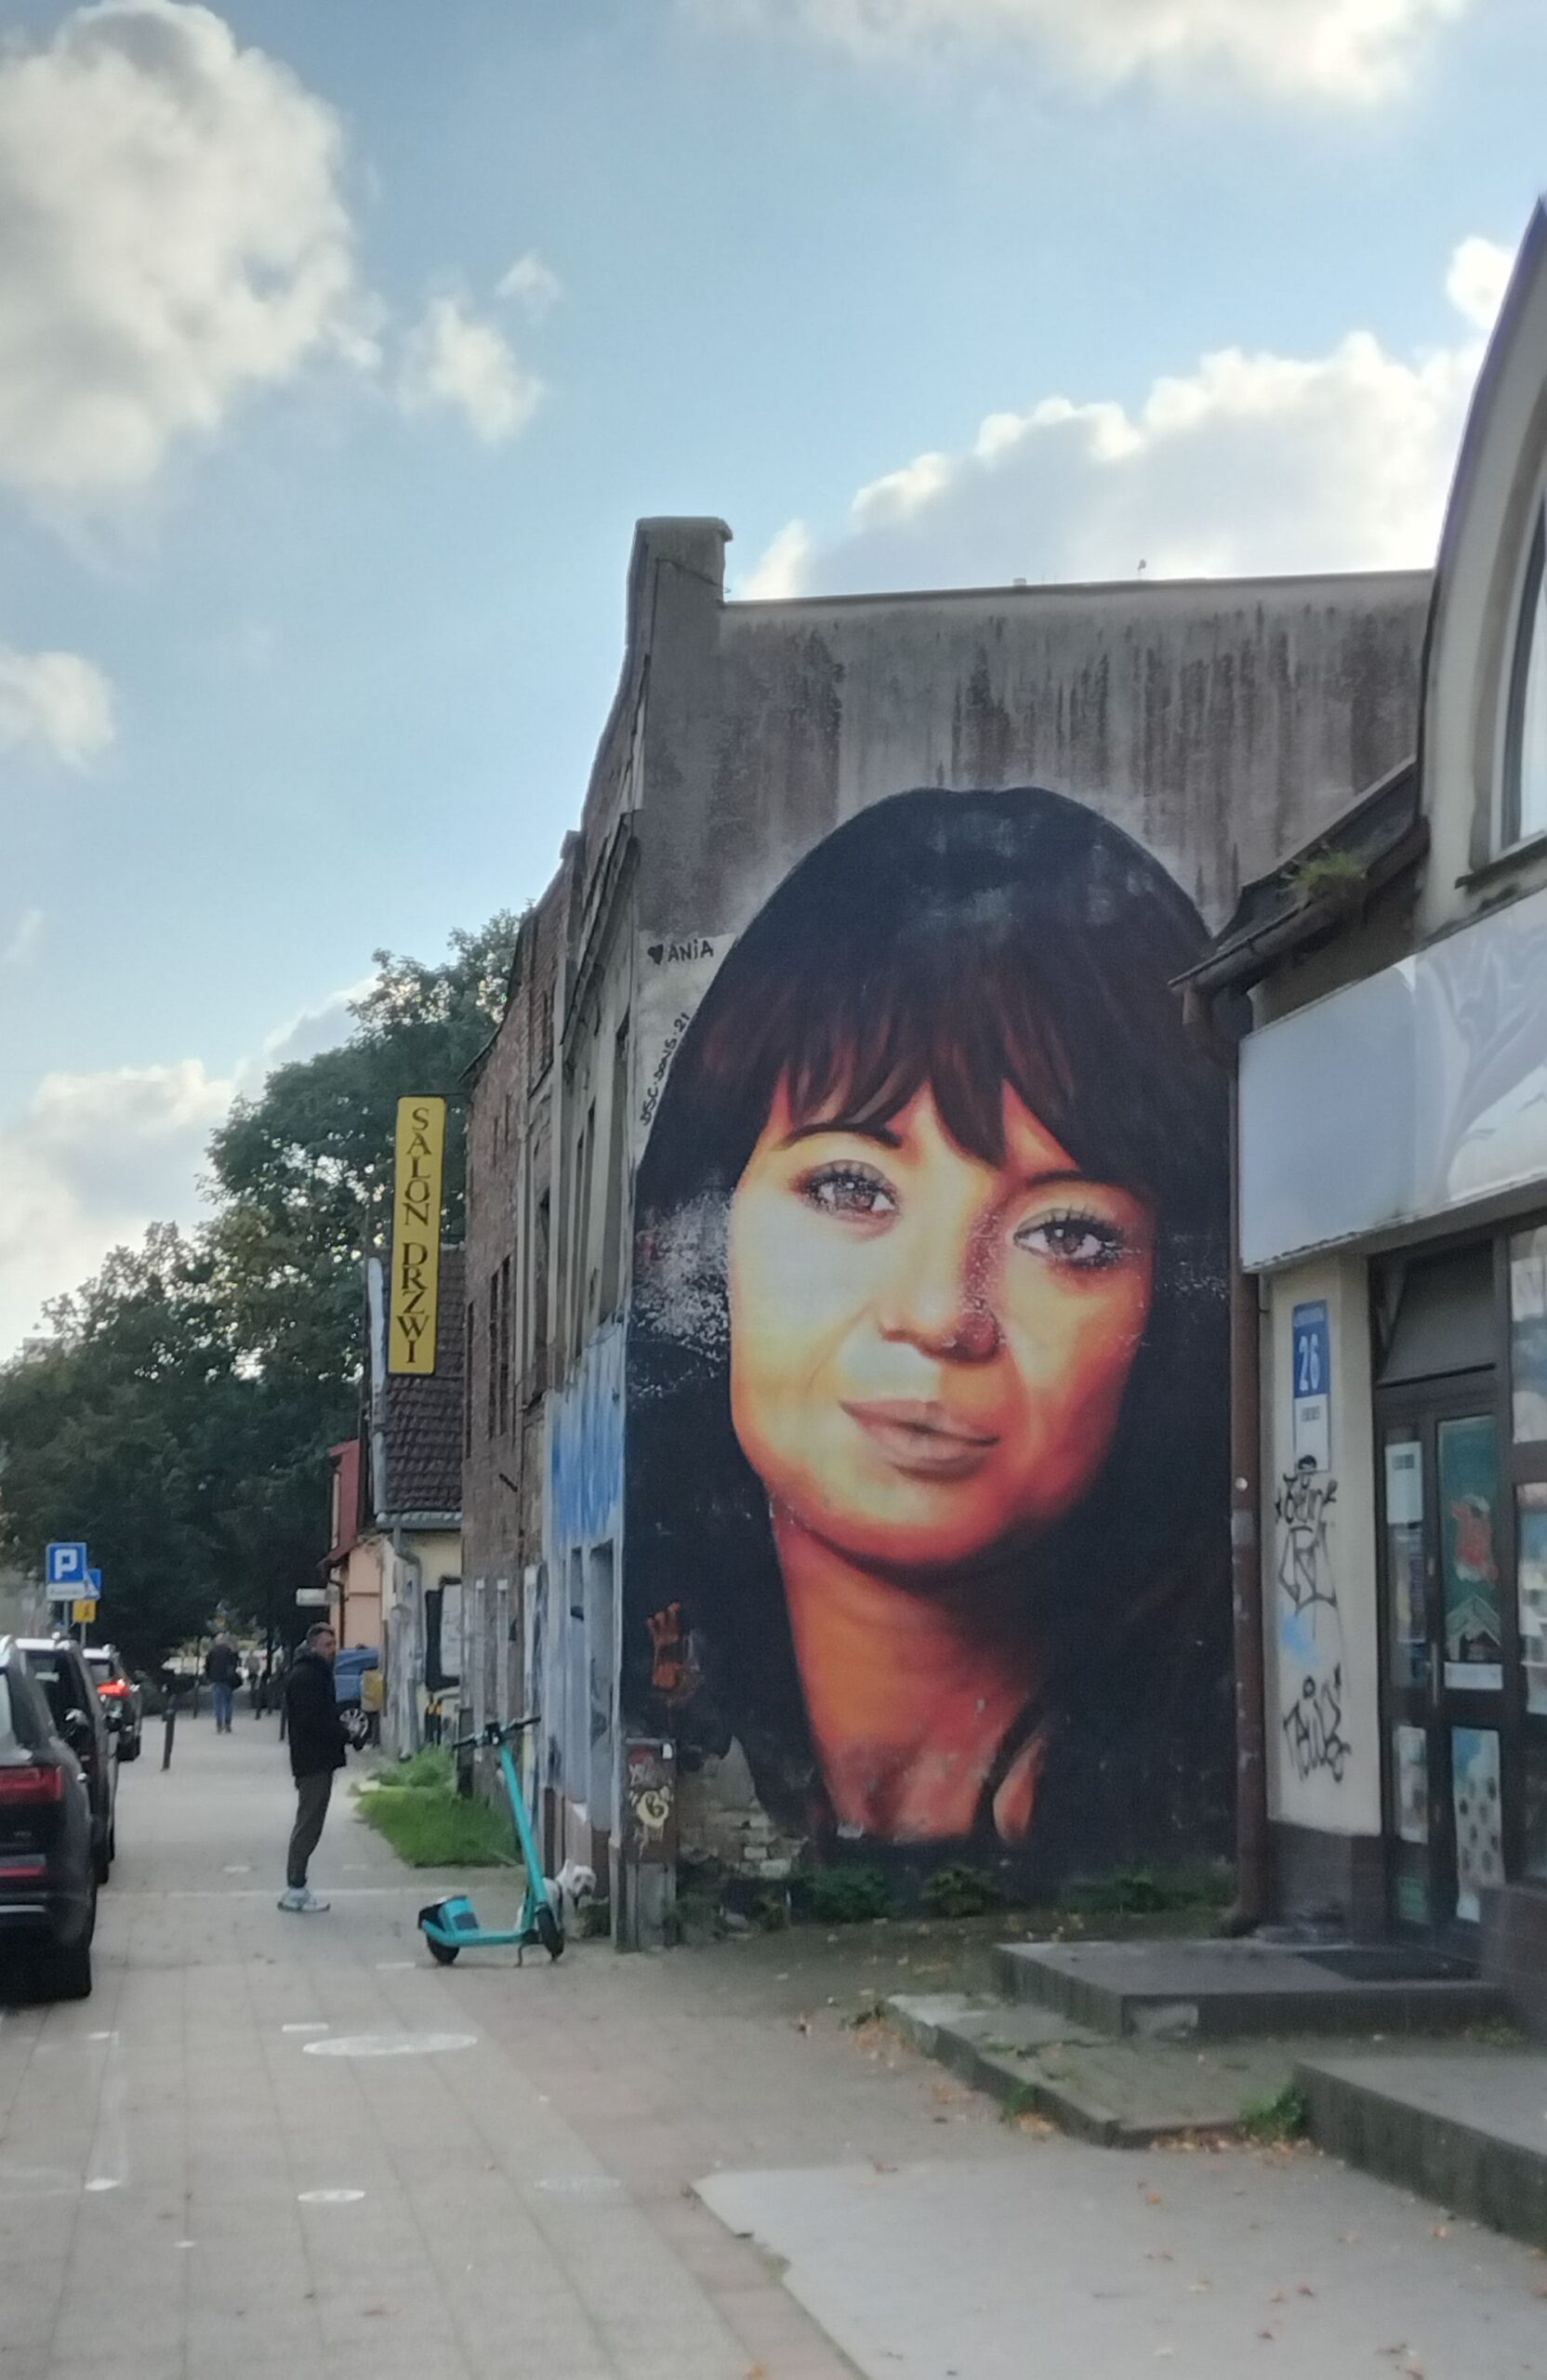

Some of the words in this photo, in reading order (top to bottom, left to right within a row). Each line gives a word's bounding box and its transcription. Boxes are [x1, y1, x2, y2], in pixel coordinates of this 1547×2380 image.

[403, 1106, 431, 1226] SALON
[396, 1242, 430, 1364] DRZWI
[1299, 1332, 1321, 1392] 26
[55, 1549, 77, 1580] P
